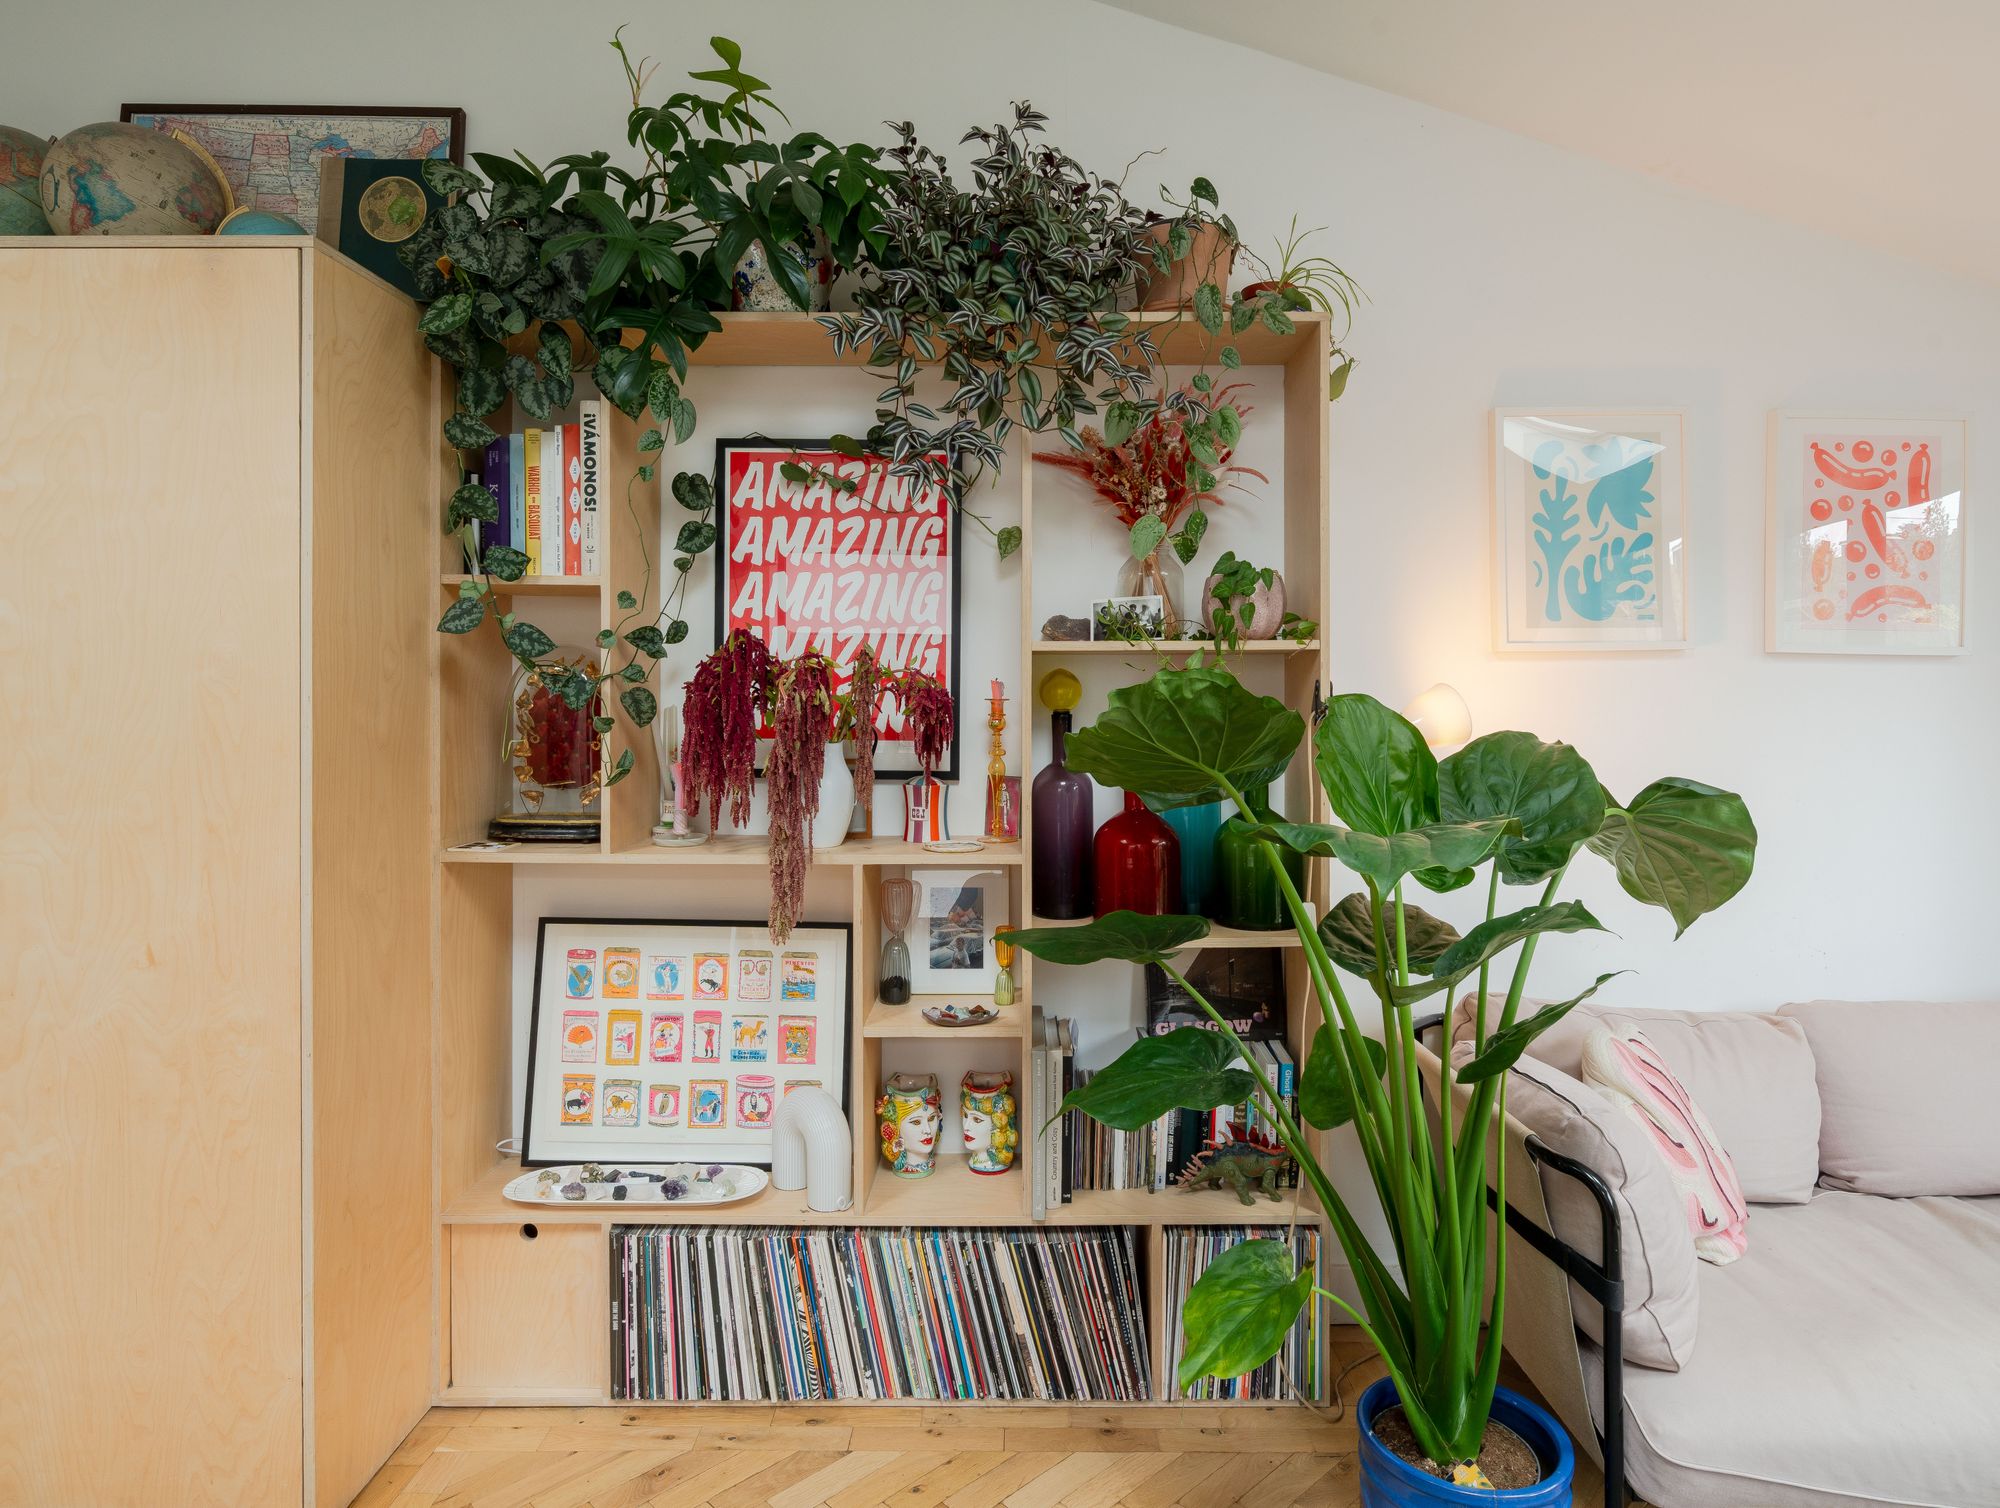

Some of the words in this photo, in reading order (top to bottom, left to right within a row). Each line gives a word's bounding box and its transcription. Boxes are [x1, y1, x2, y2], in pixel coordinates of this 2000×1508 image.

[528, 466, 540, 497] WARHOL
[528, 505, 541, 540] BASQUIAT
[732, 516, 944, 569] AMAZING
[731, 571, 944, 623] AMAZING
[1284, 1069, 1292, 1091] Ghost
[1283, 1093, 1291, 1111] Sign
